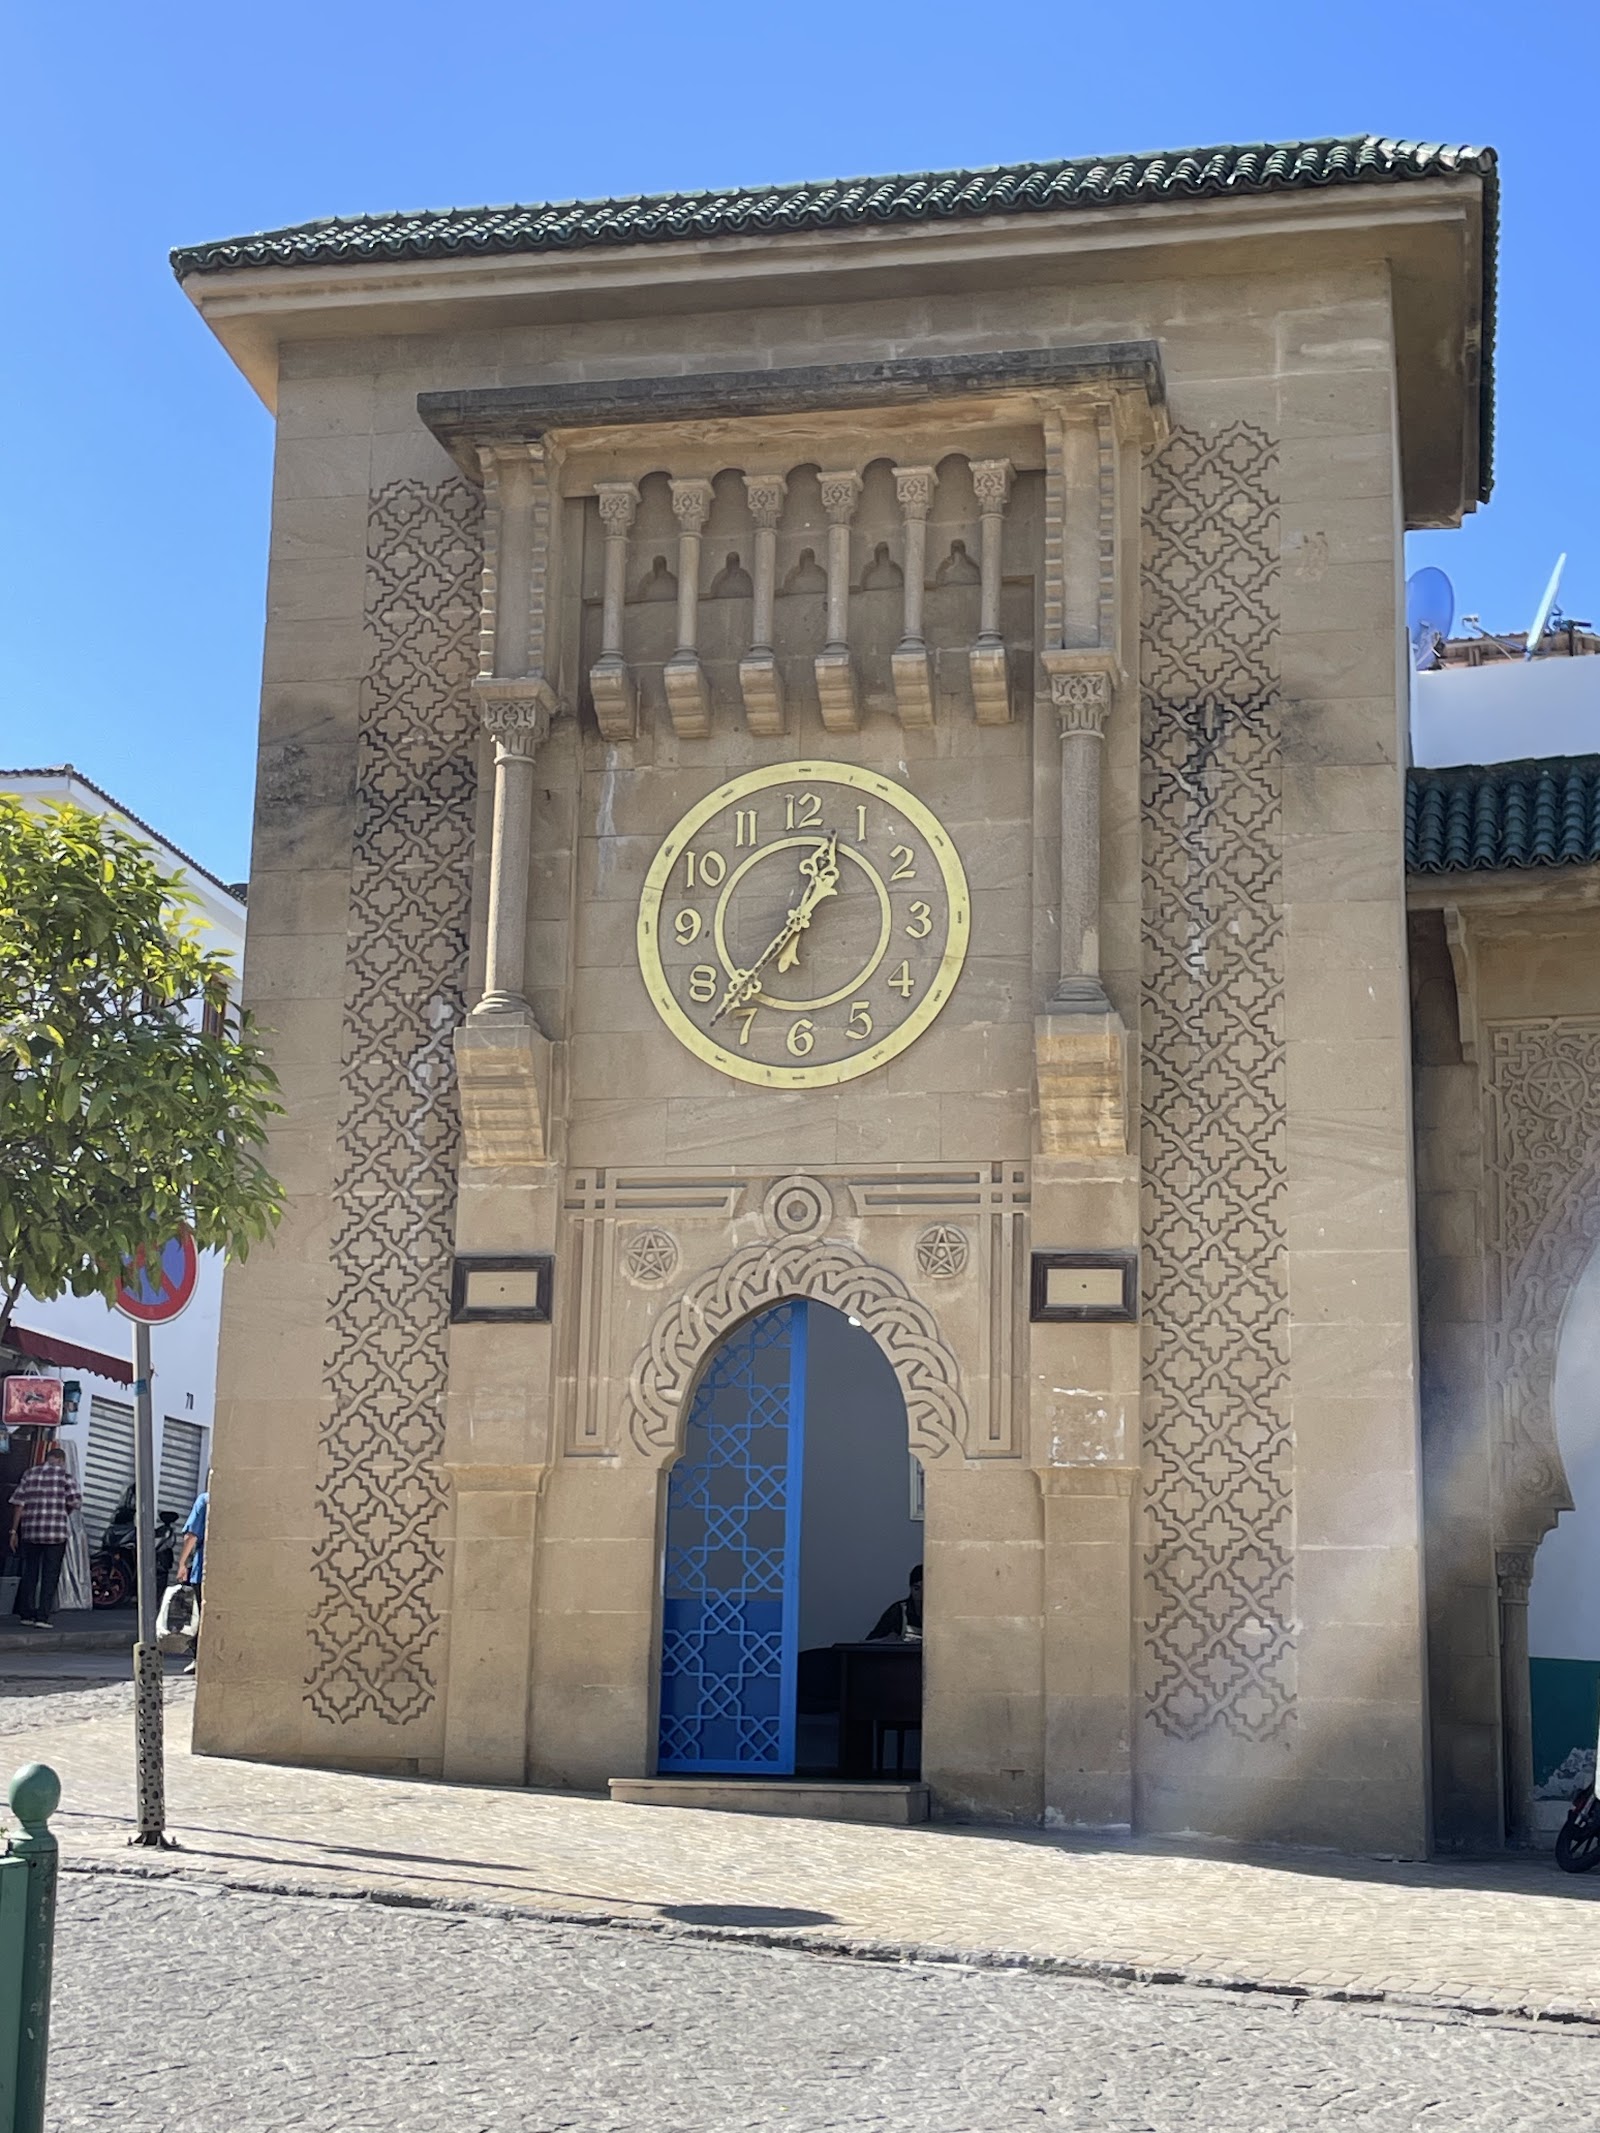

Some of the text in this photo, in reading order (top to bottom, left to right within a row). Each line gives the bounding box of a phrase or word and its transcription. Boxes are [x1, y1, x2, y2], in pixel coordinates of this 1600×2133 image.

[735, 809, 758, 847] 11
[785, 792, 824, 830] 12
[856, 805, 868, 842] 1
[686, 850, 727, 888] 10
[889, 845, 917, 882] 2
[674, 908, 702, 946] 9
[905, 900, 933, 938] 3
[689, 964, 717, 1003] 8
[887, 960, 915, 998] 4
[730, 1007, 758, 1045] 7
[786, 1018, 815, 1057] 6
[845, 1001, 874, 1040] 5
